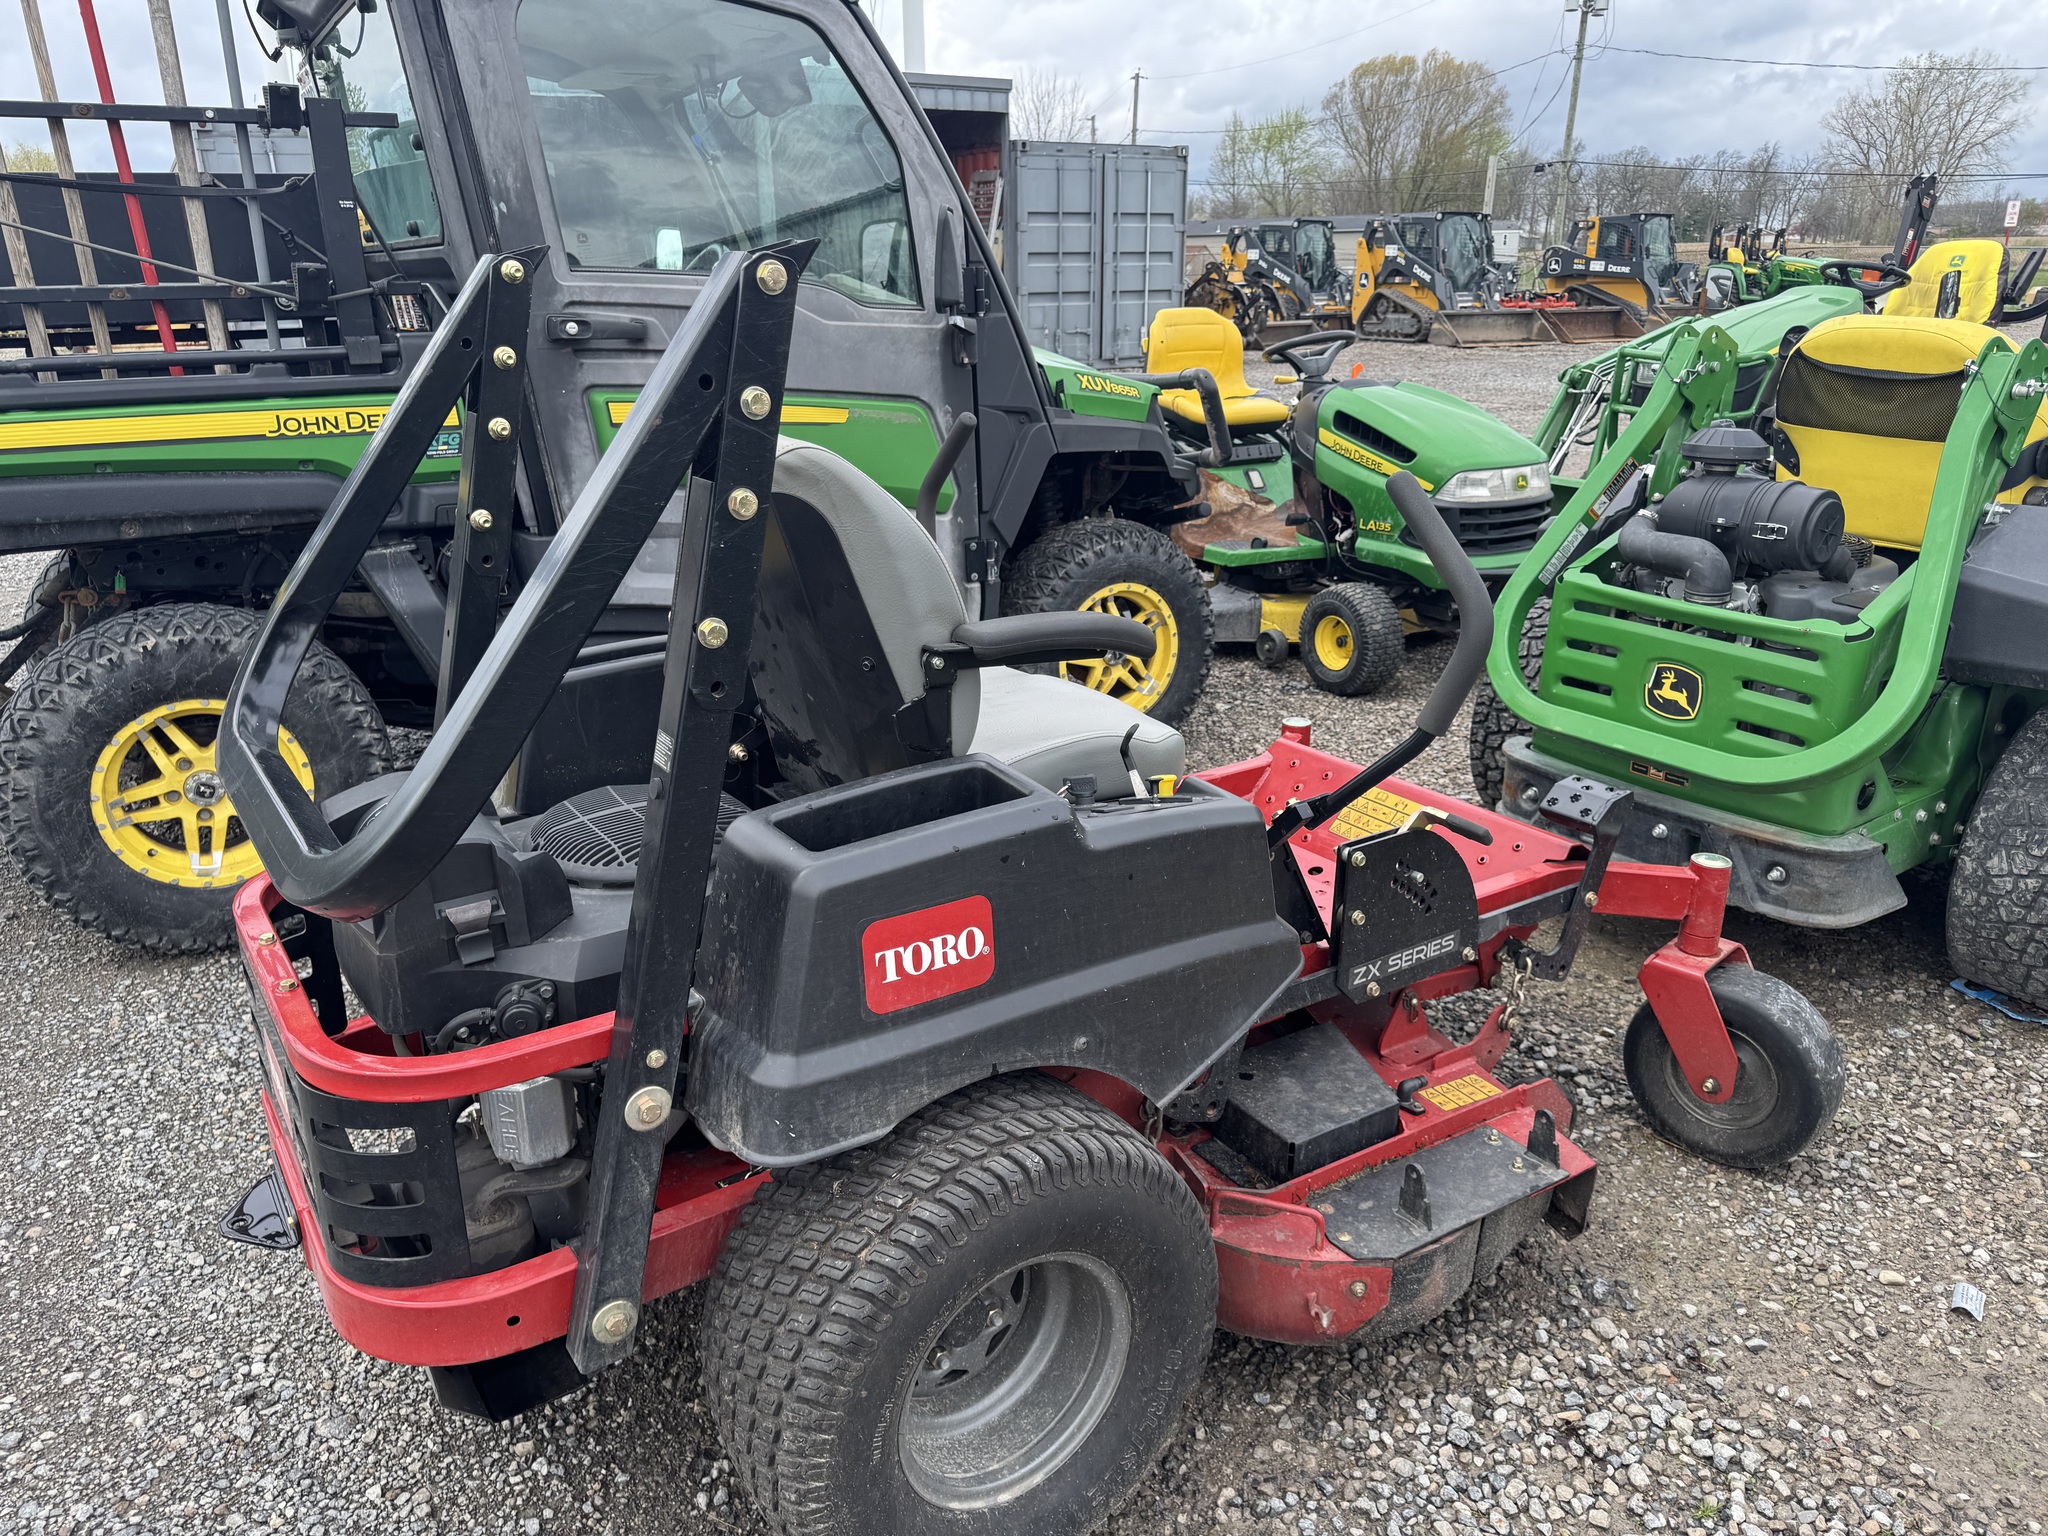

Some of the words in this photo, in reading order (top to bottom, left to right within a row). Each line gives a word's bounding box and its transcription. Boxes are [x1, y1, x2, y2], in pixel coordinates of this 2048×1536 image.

[1607, 264, 1631, 273] DEERE
[1076, 373, 1140, 398] XUV865R
[268, 414, 340, 434] JOHN
[1330, 439, 1353, 459] JOHN
[1353, 450, 1384, 471] DEERE
[1359, 518, 1391, 531] LA135
[1353, 961, 1381, 985] ZX
[1388, 934, 1455, 973] SERIES
